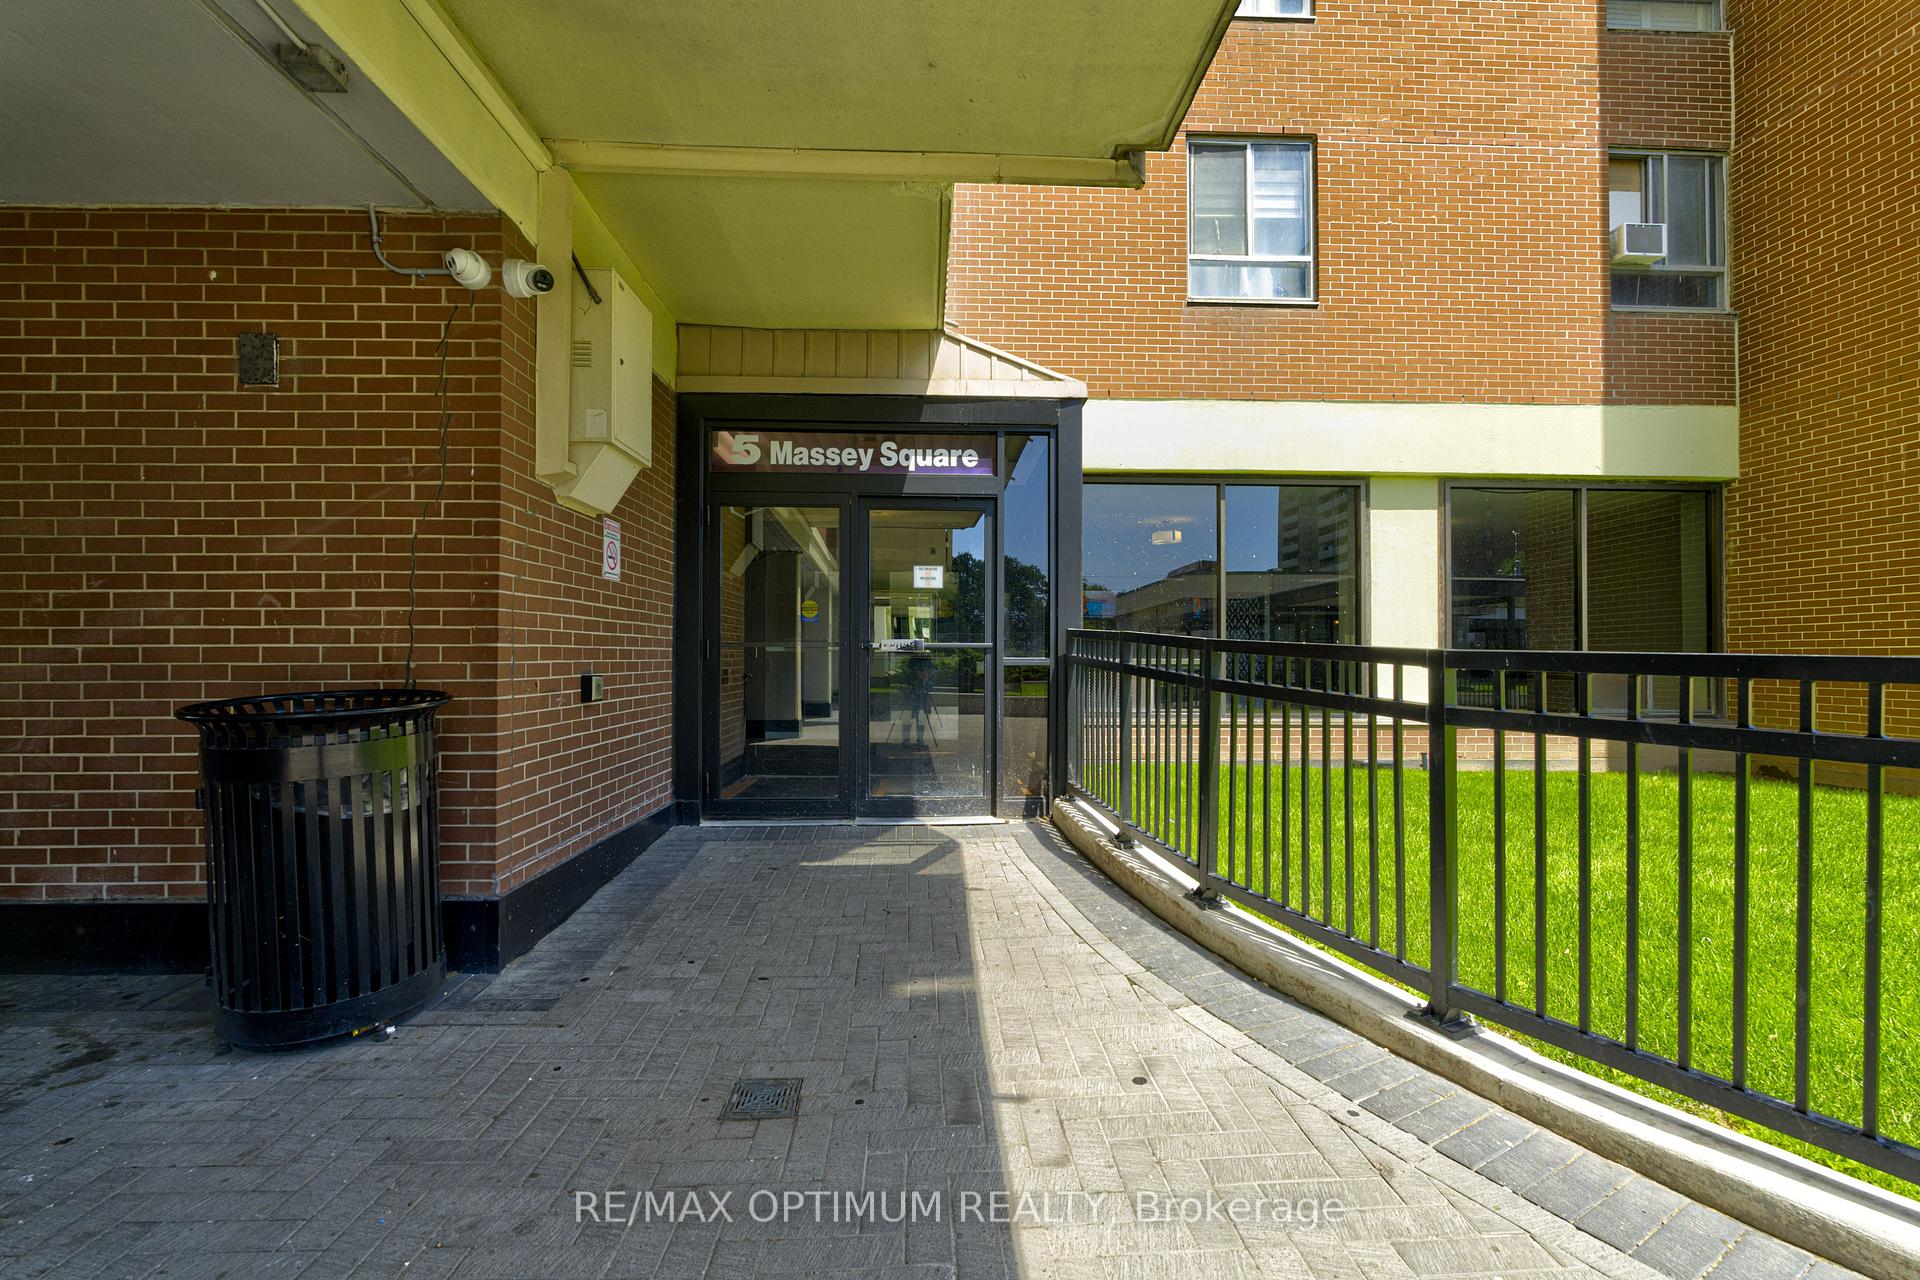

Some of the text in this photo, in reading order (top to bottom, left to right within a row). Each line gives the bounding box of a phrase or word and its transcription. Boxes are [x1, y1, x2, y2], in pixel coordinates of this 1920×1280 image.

[732, 434, 979, 471] 5 Massey Square
